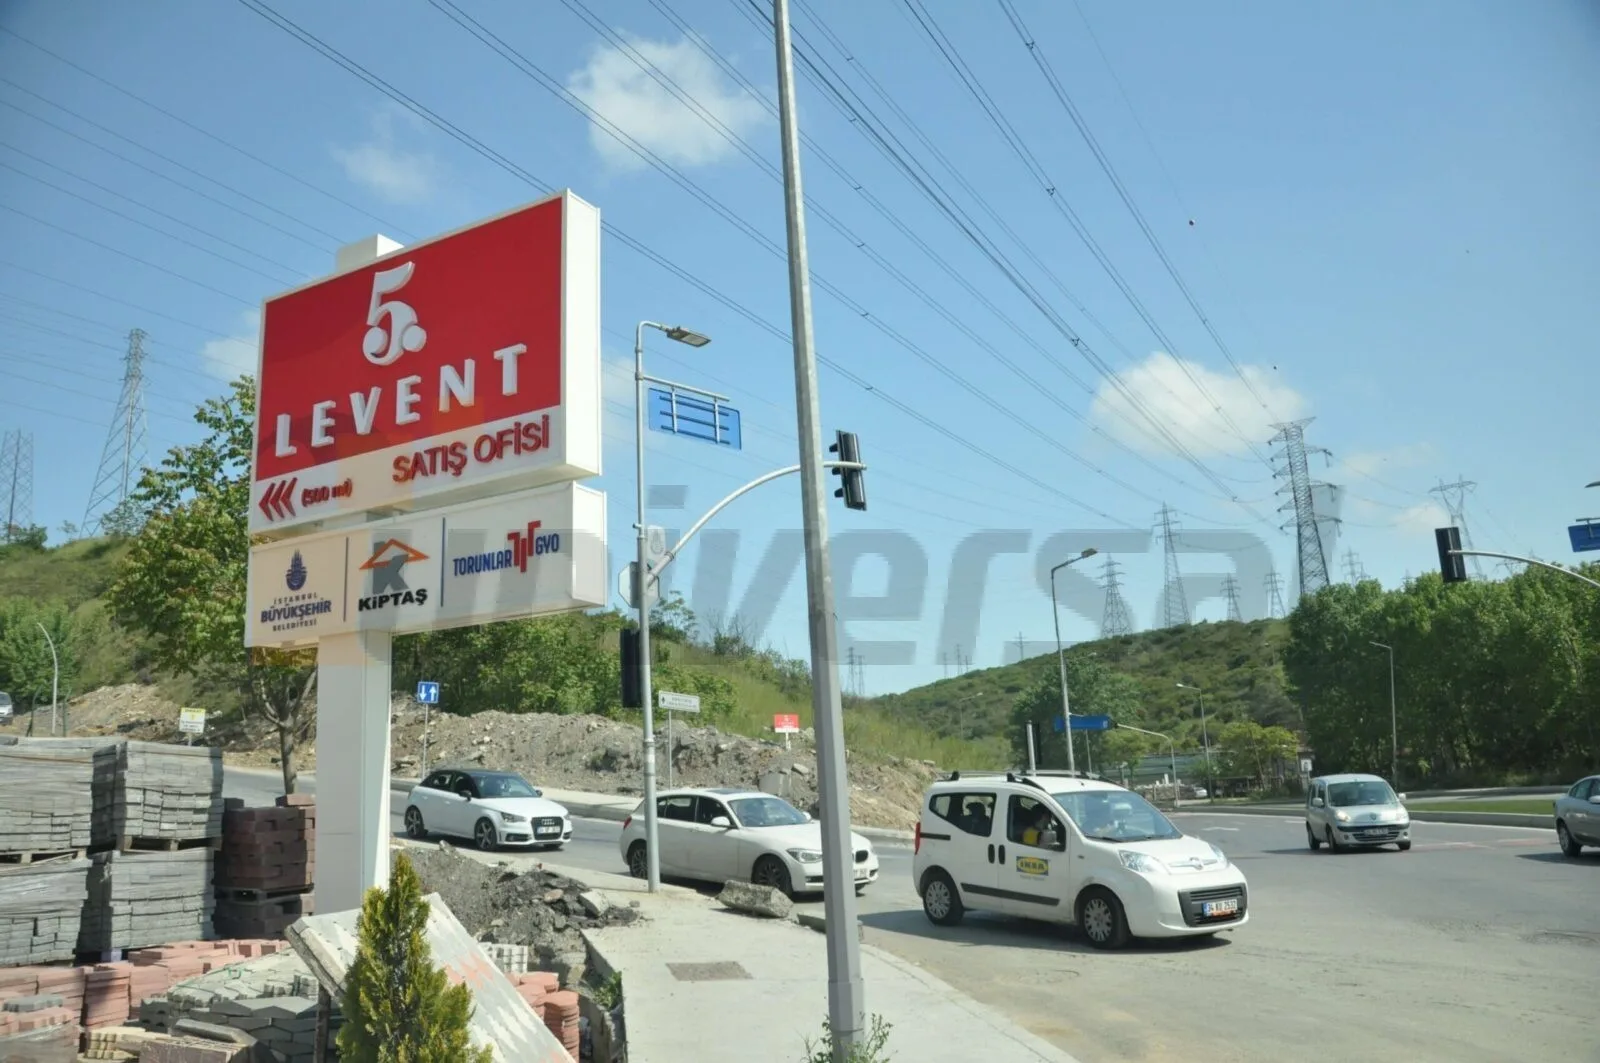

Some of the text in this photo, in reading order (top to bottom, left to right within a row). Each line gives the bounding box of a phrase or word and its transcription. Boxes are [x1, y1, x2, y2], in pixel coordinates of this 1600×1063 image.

[275, 342, 528, 458] LEVENT
[392, 413, 550, 483] SATIŞ OFİSİ
[453, 532, 560, 577] TORUNLAR GYO
[260, 597, 332, 623] BÜYÜKŞEHİR
